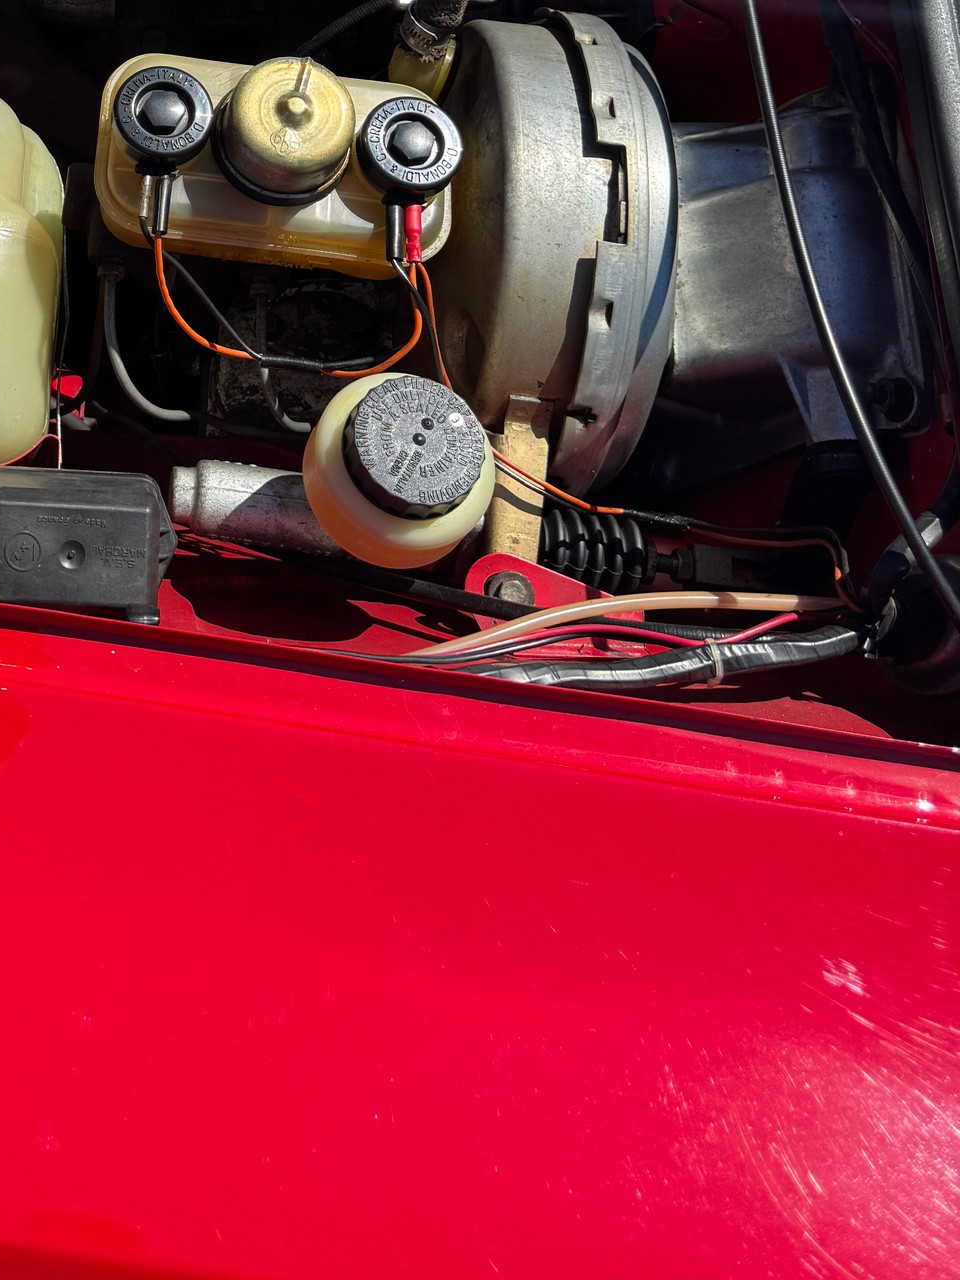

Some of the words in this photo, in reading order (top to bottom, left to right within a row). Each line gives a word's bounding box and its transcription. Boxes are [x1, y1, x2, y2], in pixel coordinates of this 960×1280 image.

[367, 382, 400, 409] CLEAN
[403, 378, 448, 400] FILLER
[371, 402, 394, 422] USE
[392, 389, 421, 404] ONLY
[355, 407, 374, 471] WARNING:
[380, 421, 395, 458] FROM
[388, 410, 401, 422] A
[400, 402, 448, 424] SEALED
[418, 468, 477, 504] REMOVING
[92, 545, 146, 559] MARCHAL
[101, 556, 137, 569] S.E.V.
